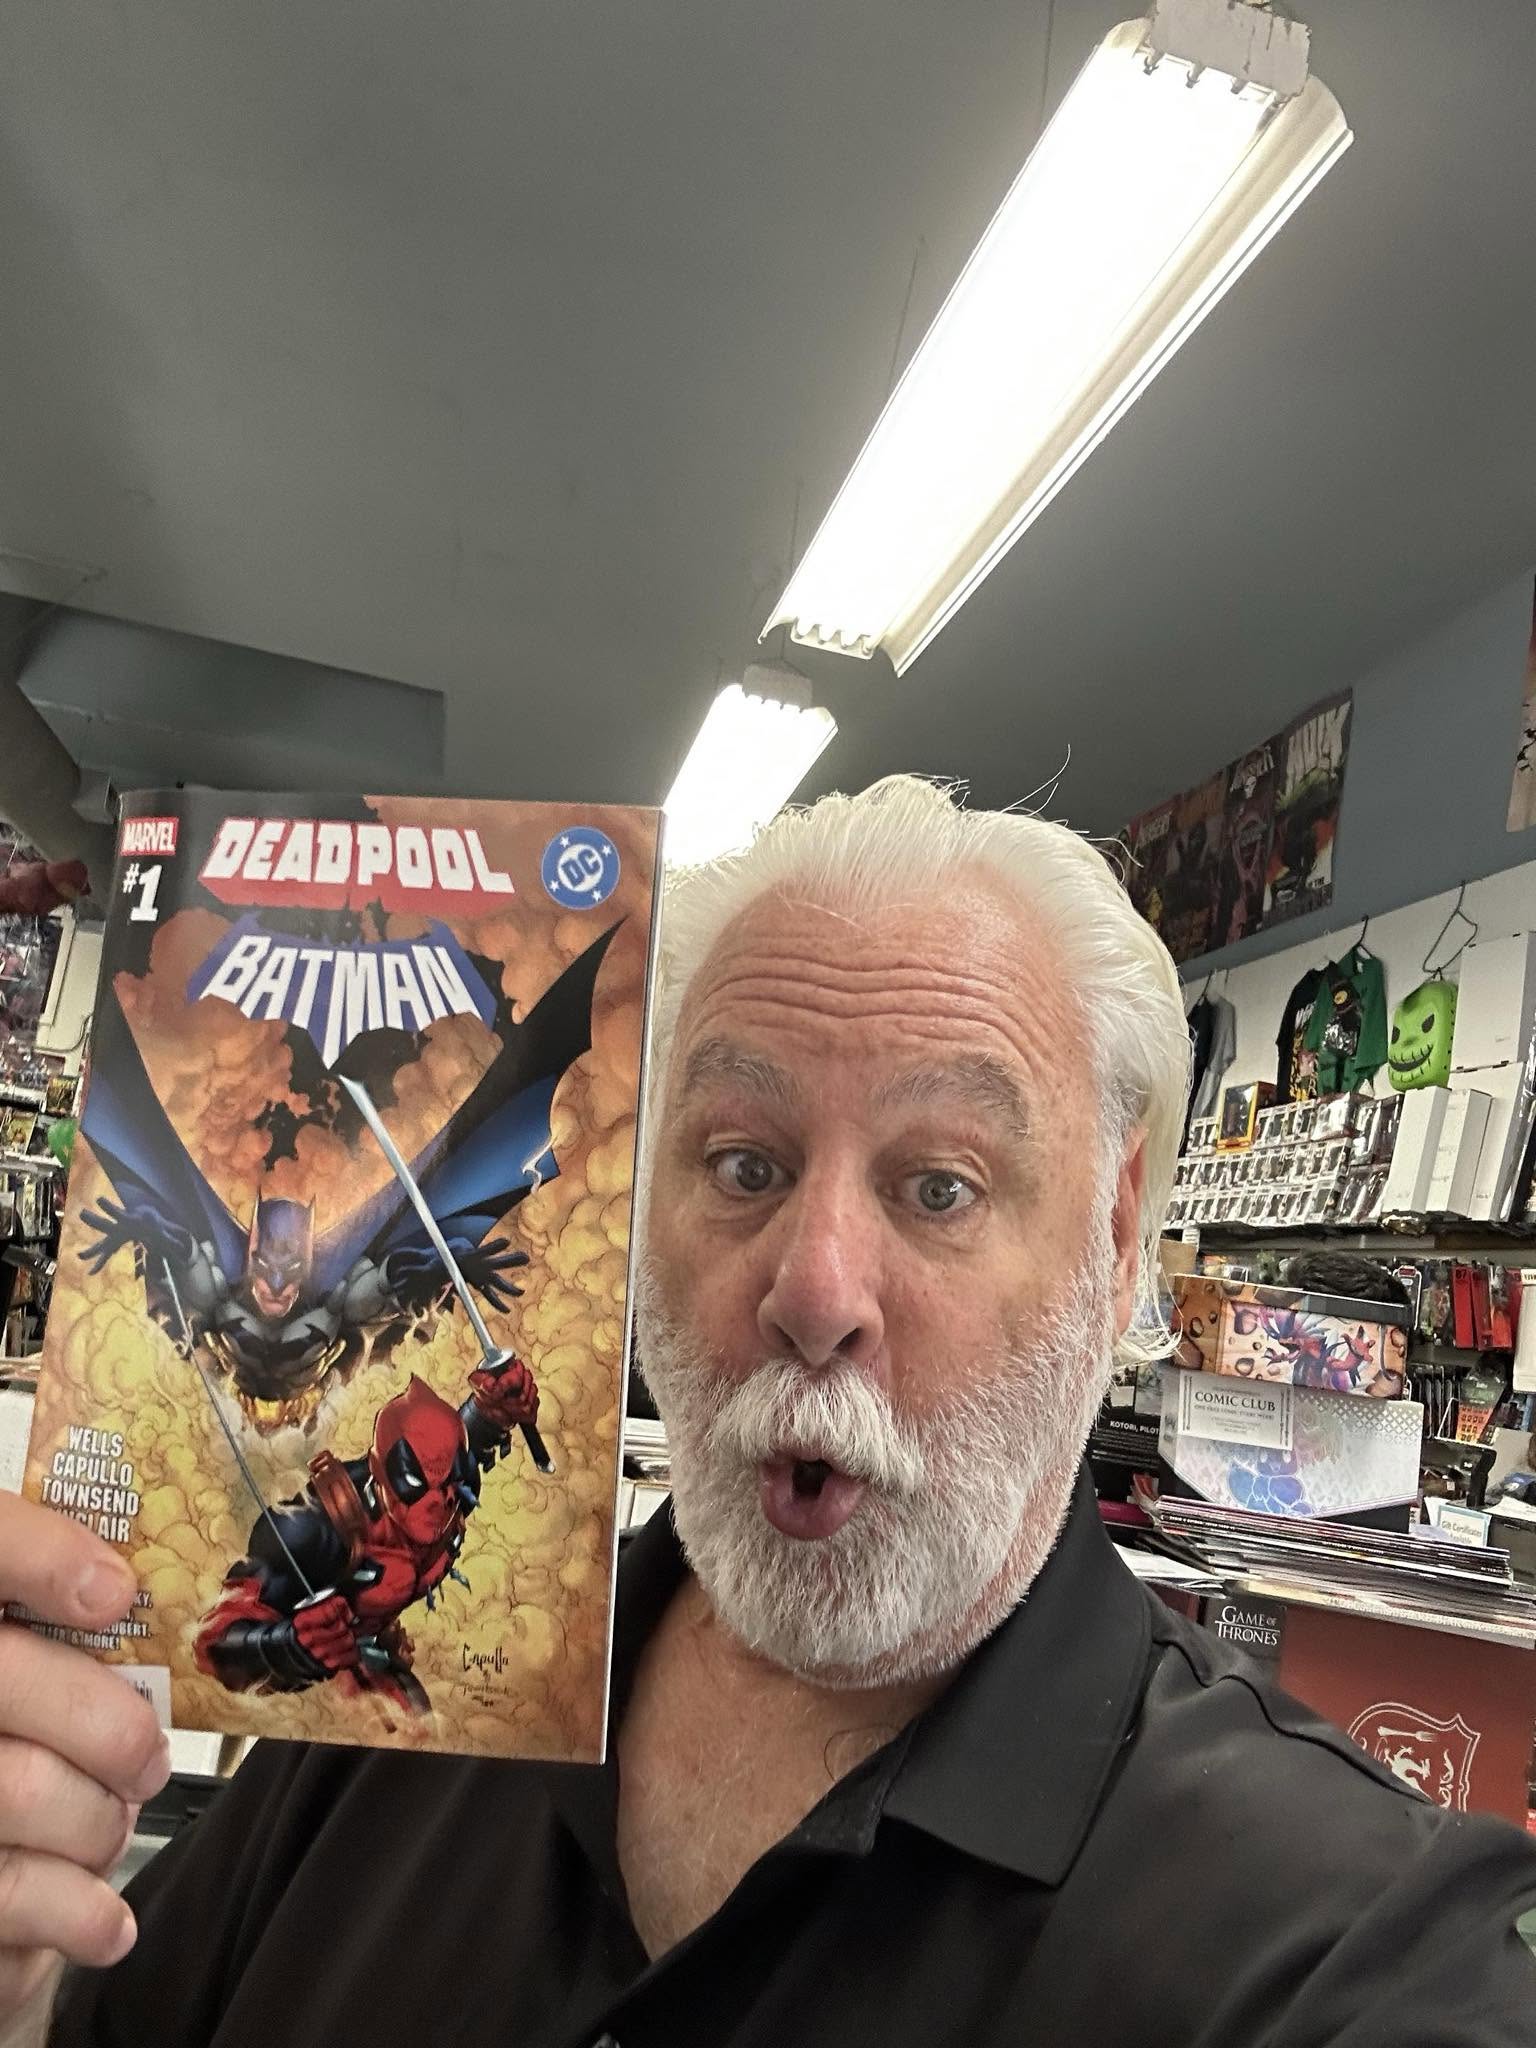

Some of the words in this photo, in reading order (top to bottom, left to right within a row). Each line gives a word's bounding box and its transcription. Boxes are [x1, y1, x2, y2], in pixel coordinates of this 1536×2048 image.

[121, 819, 177, 854] MARVEL
[201, 819, 516, 894] DEADPOOL
[560, 848, 601, 888] DC
[122, 863, 162, 921] #1
[199, 935, 485, 1070] BATMAN
[1194, 1391, 1239, 1407] COMIC
[1241, 1397, 1276, 1412] CLUB
[68, 1425, 124, 1458] WELLS
[51, 1451, 134, 1487] CAPULLO
[41, 1477, 140, 1516] TOWNSEND
[1214, 1620, 1280, 1646] THRONES
[1221, 1605, 1265, 1627] GAME
